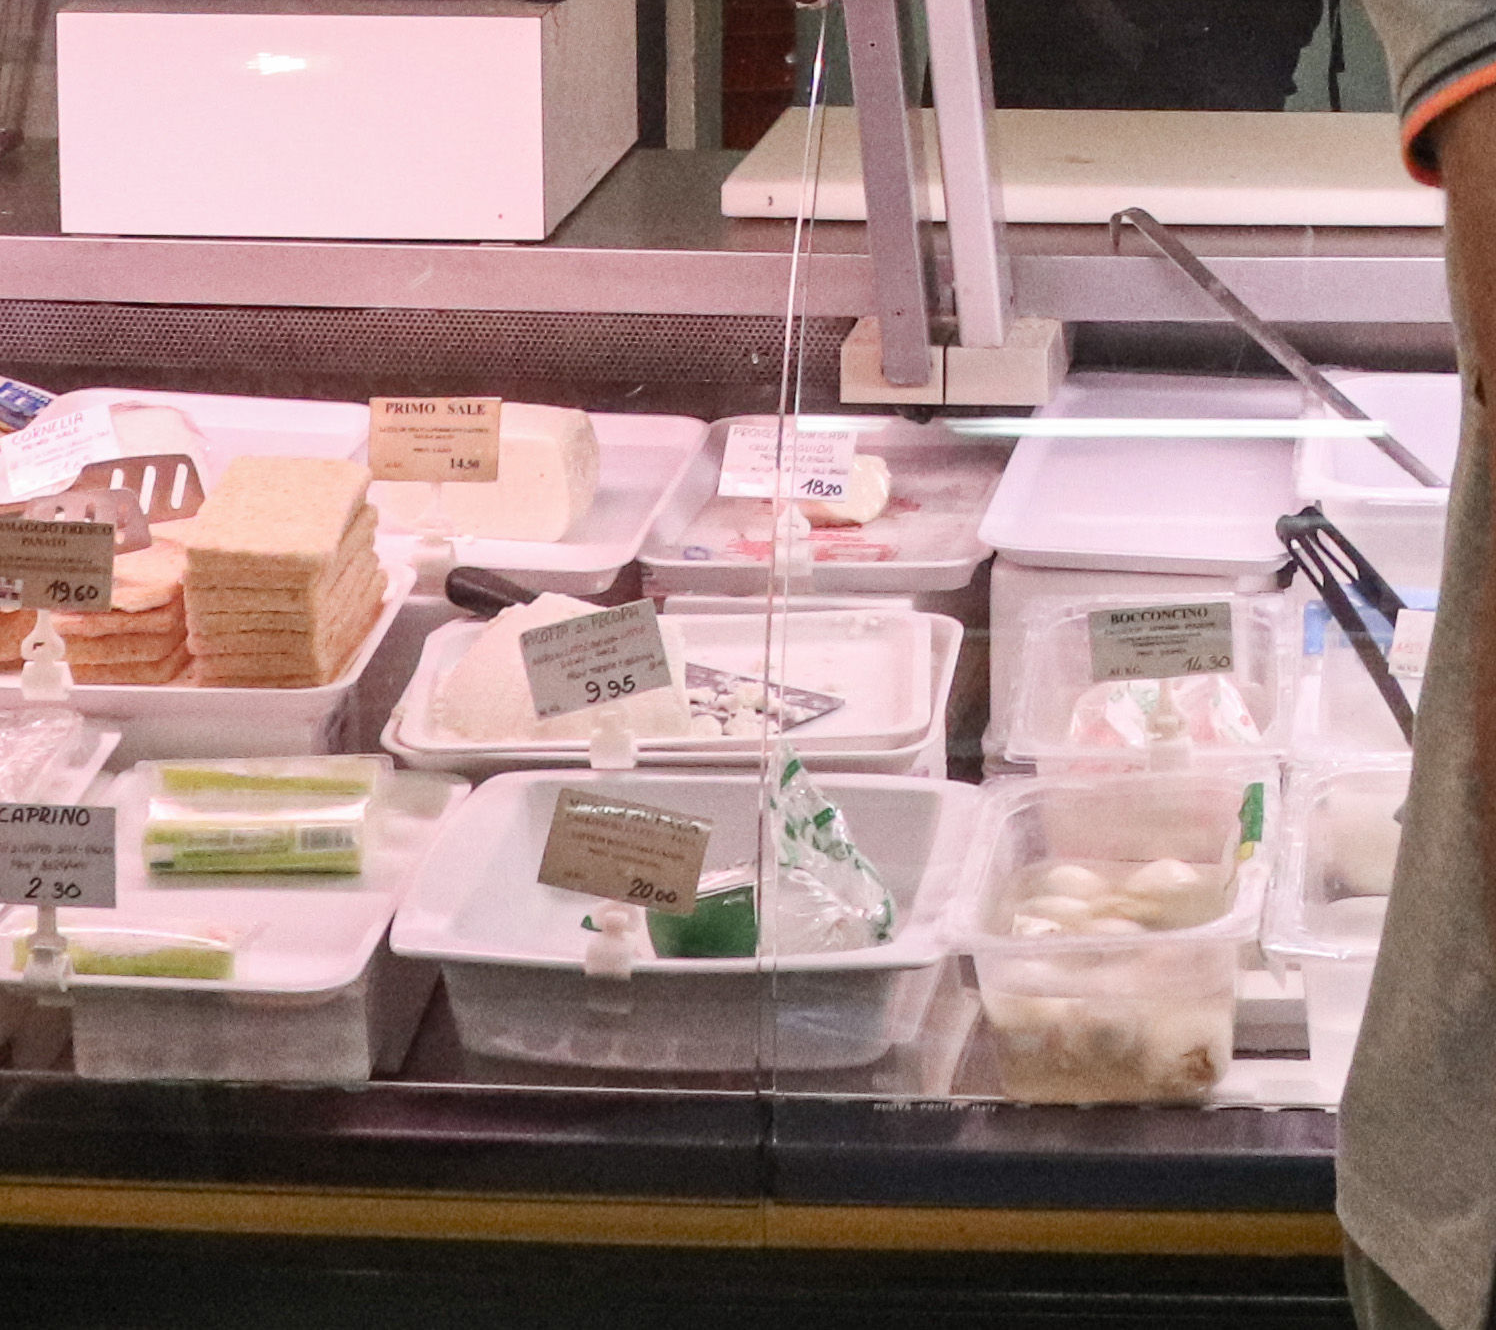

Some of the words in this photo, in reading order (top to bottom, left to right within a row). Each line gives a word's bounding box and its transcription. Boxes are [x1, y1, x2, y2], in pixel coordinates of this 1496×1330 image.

[384, 401, 437, 417] PRIMO
[446, 401, 487, 418] SALE
[590, 604, 640, 629] PECORA
[1109, 606, 1209, 627] BOCCONCINO
